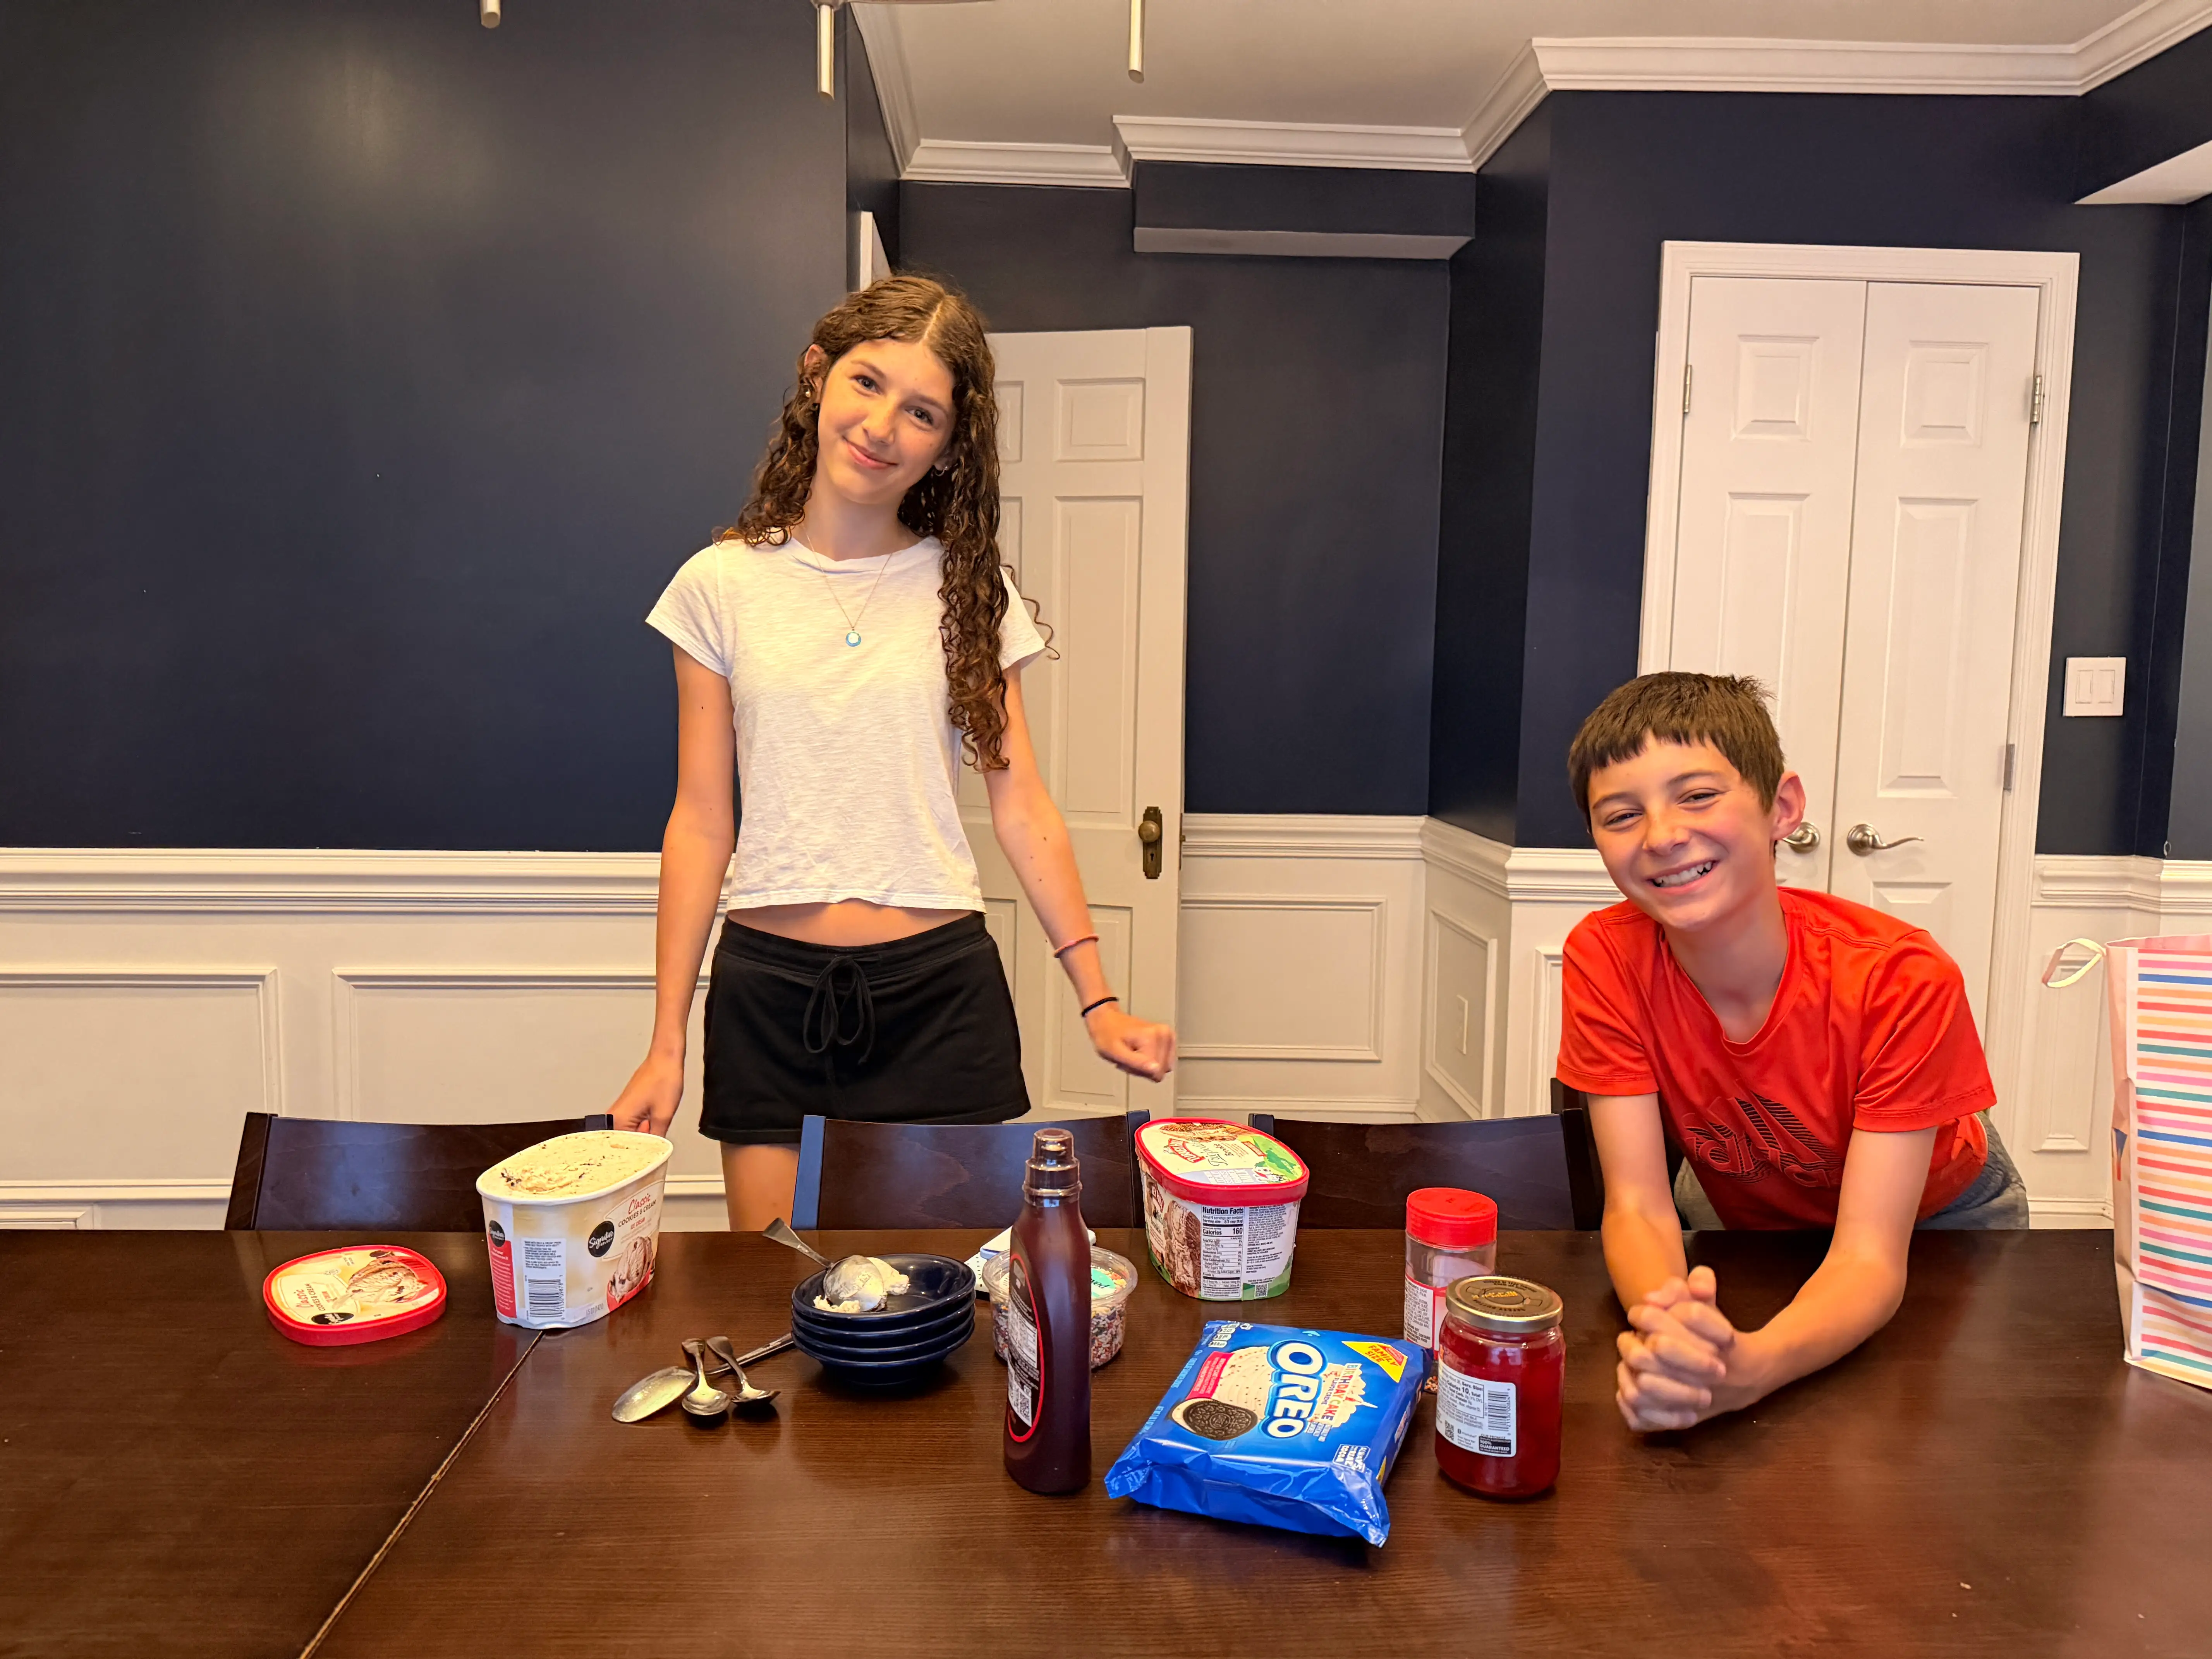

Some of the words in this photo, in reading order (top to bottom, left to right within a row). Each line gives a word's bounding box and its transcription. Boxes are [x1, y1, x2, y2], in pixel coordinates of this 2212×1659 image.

[1171, 1147, 1200, 1162] TURKEY
[628, 1193, 651, 1214] Classic
[618, 1211, 639, 1227] COOKIES
[643, 1200, 656, 1213] CREAM
[304, 1283, 316, 1295] CREAM
[294, 1289, 314, 1308] Classic
[312, 1298, 326, 1311] COOKIES
[1473, 1299, 1497, 1310] BUTTON
[1365, 1350, 1385, 1362] SIZE
[1368, 1345, 1398, 1367] FAMILY
[1266, 1341, 1324, 1439] OREO
[1329, 1377, 1340, 1392] FLAVOR
[1333, 1364, 1358, 1401] BIRTHDAY
[1447, 1380, 1460, 1391] Calories
[1462, 1387, 1470, 1396] 10,
[1321, 1391, 1333, 1405] CREME
[1455, 1393, 1467, 1403] Protein
[1321, 1399, 1340, 1421] CAKE
[1335, 1445, 1350, 1463] COCOA
